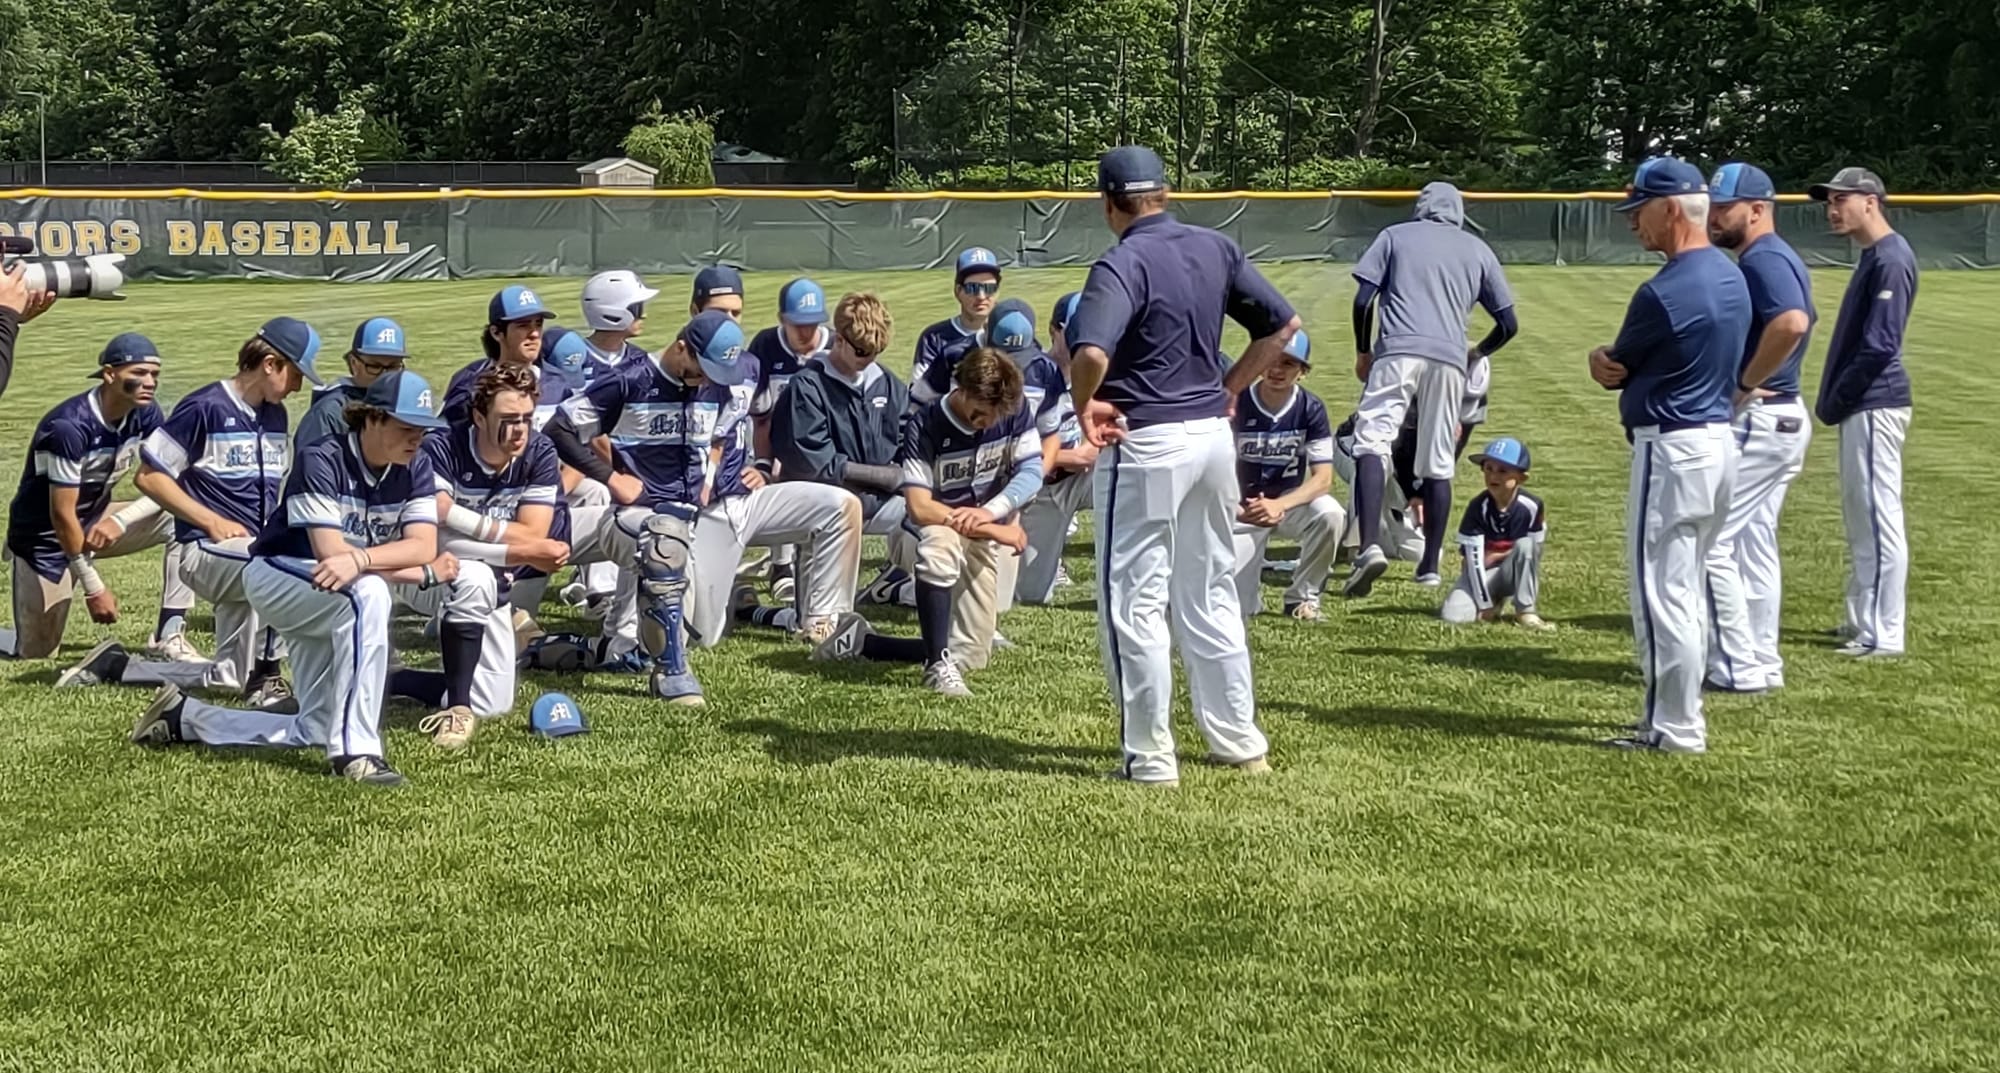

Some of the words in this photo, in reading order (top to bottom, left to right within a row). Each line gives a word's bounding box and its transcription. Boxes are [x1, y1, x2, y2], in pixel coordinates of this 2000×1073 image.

[166, 220, 410, 255] BASEBALL
[519, 290, 537, 305] M
[799, 292, 816, 308] M
[377, 328, 395, 344] M
[416, 389, 432, 408] M
[834, 634, 851, 654] N
[550, 702, 572, 722] M
